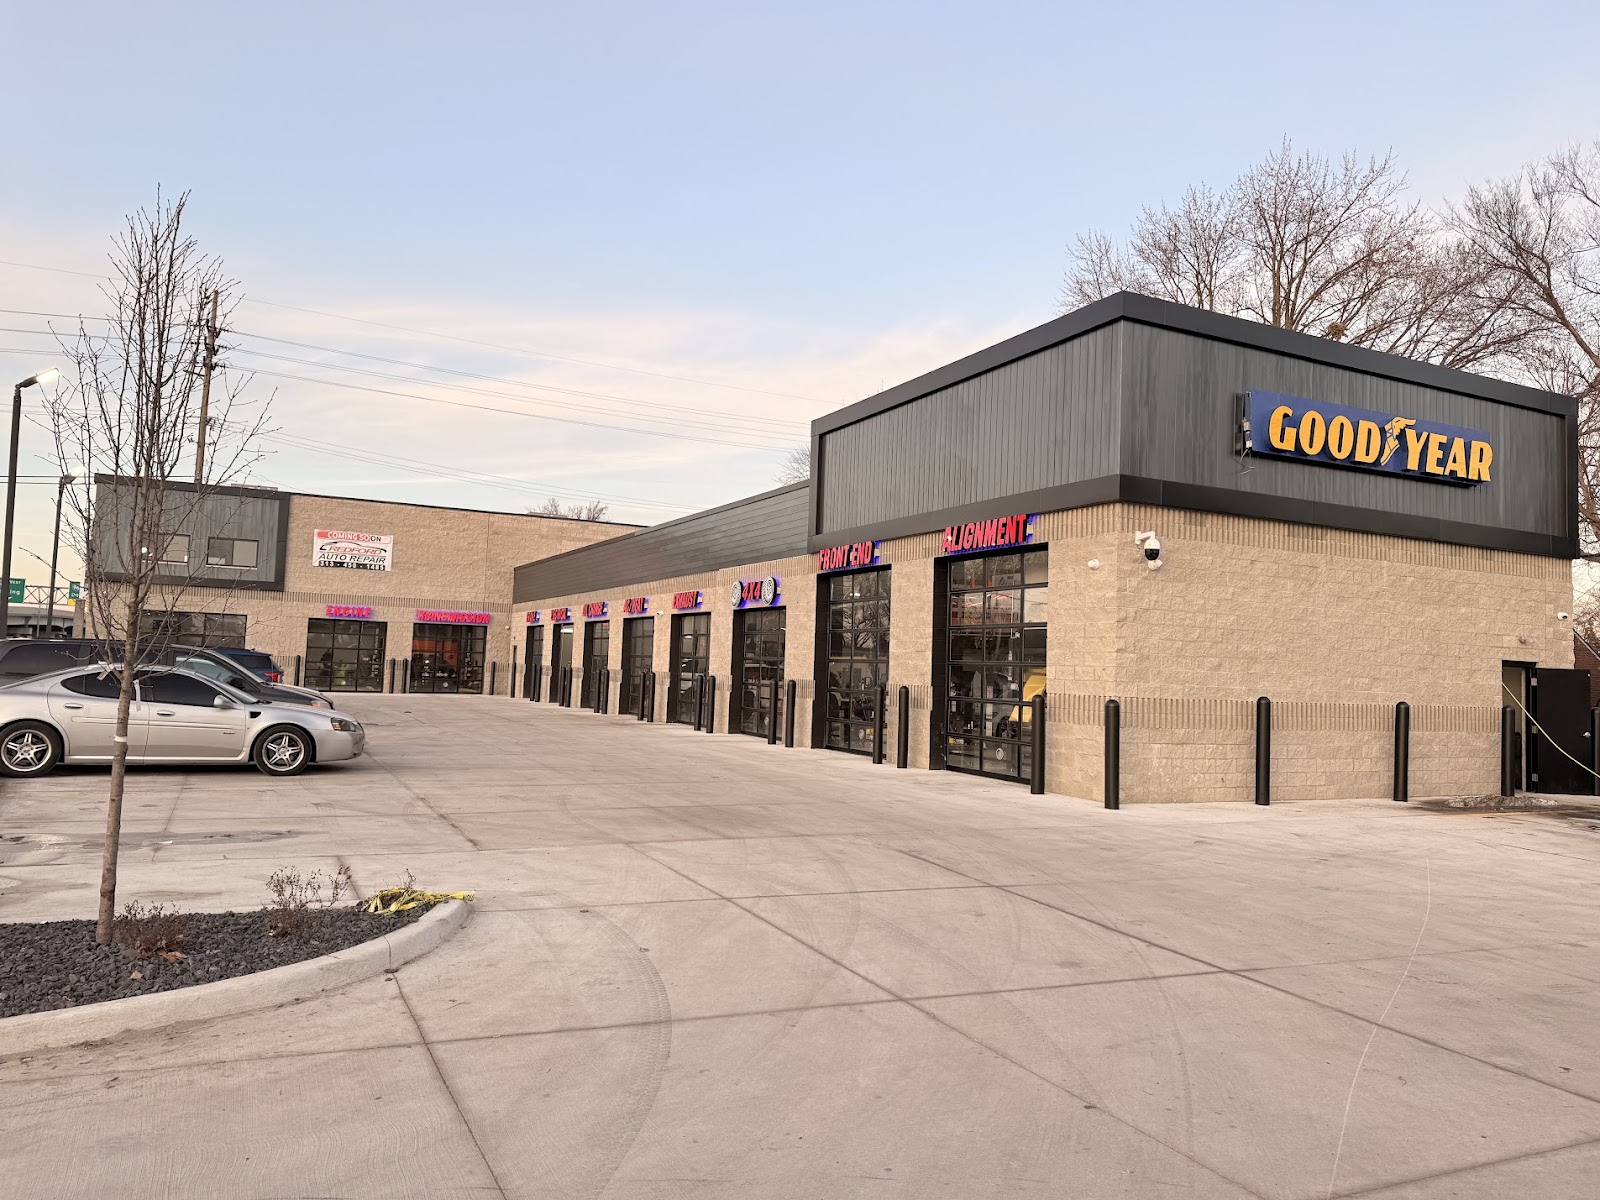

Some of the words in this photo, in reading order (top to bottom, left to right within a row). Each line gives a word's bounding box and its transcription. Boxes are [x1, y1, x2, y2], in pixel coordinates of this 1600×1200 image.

[1269, 406, 1493, 482] GOODYEAR
[328, 532, 358, 541] COMING
[360, 534, 382, 542] SOON
[942, 514, 1026, 552] ALIGNMENT
[329, 545, 382, 555] REDFORD
[818, 545, 850, 570] FRONT
[851, 541, 873, 566] END
[318, 553, 347, 561] AUTO
[349, 555, 386, 564] REPAIR
[742, 581, 761, 600] 4X4
[326, 604, 372, 618] ENGINE
[416, 609, 491, 624] TRANSMISSION
